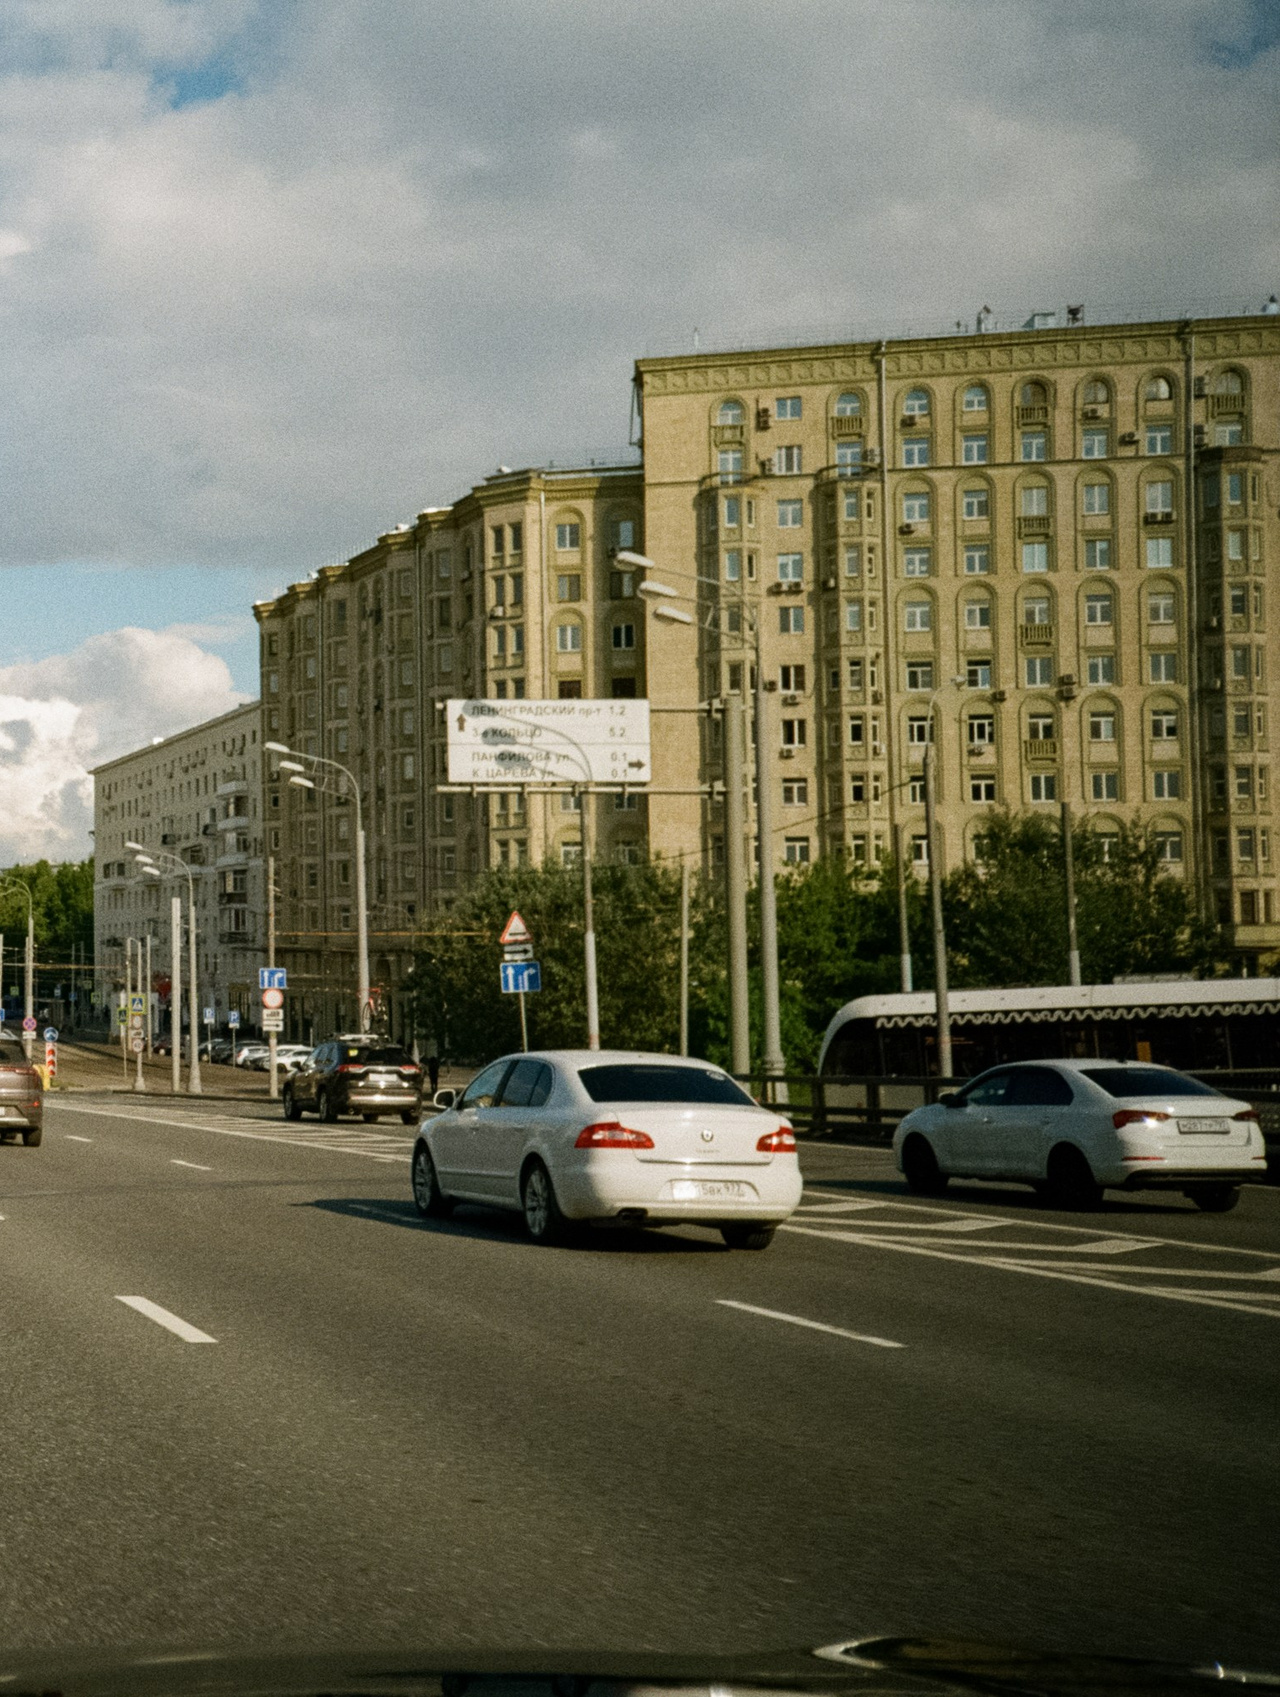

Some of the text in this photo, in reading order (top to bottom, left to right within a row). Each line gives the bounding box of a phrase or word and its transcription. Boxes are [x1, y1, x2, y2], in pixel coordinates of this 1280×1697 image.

[471, 704, 576, 716] ЛЕНИНГРАДСКИЙ
[472, 727, 489, 738] 3е
[491, 727, 542, 738] КОЛЬЦО
[471, 751, 551, 762] ПАНФИЛОВА
[486, 768, 537, 780] ЦАРЕВА
